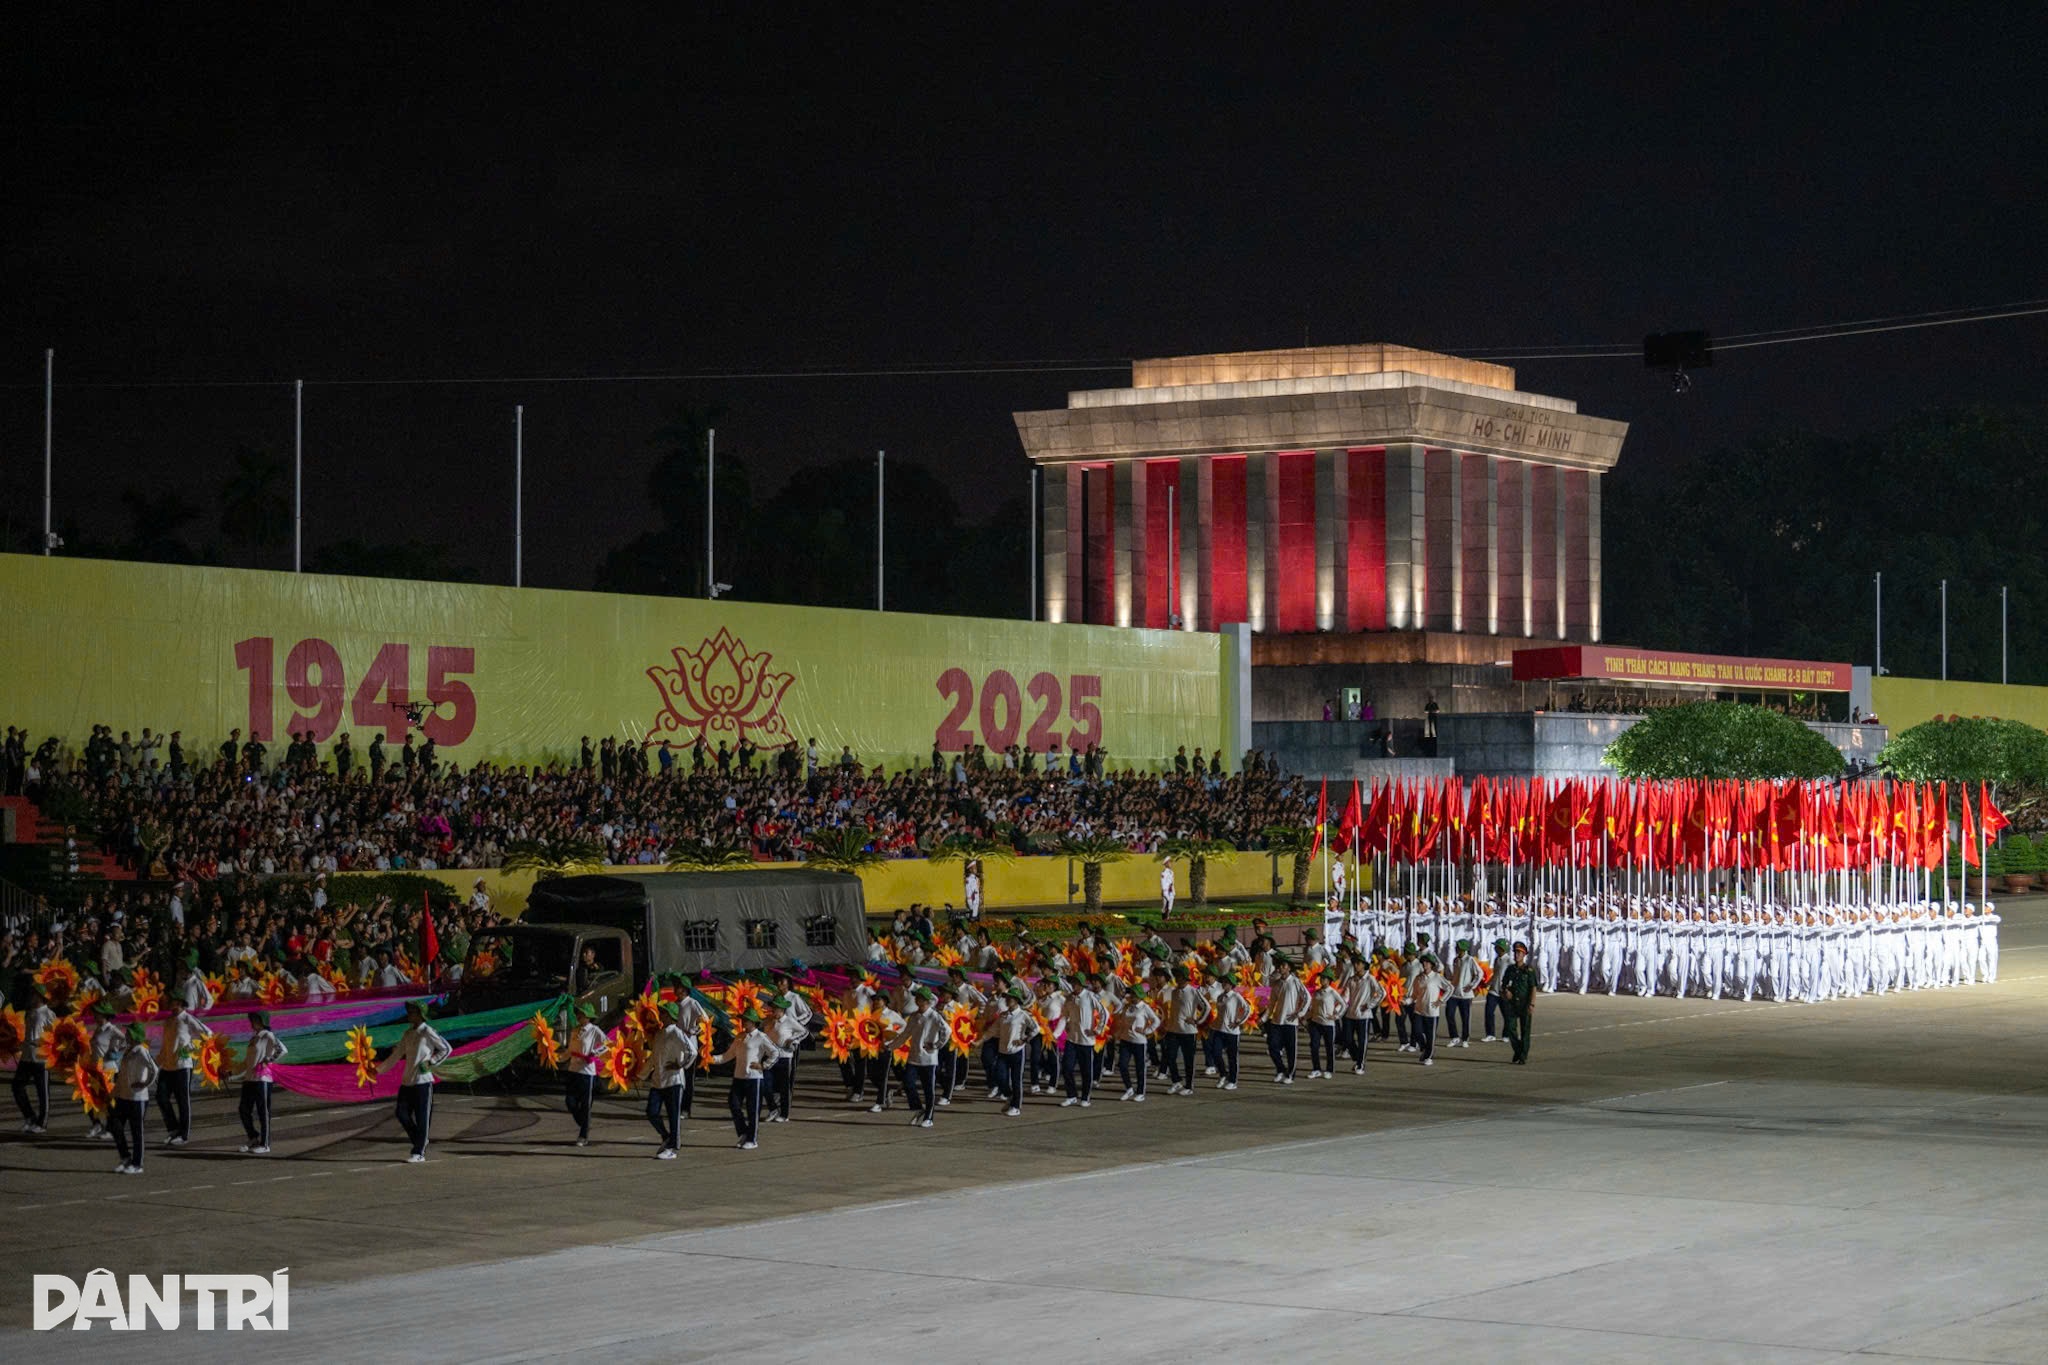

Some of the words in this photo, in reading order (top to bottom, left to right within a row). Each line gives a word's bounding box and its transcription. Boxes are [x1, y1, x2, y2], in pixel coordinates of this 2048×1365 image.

[234, 637, 477, 746] 1945
[936, 668, 1102, 754] 2025
[1605, 657, 1625, 673] TINH
[1788, 668, 1800, 683] 2-9
